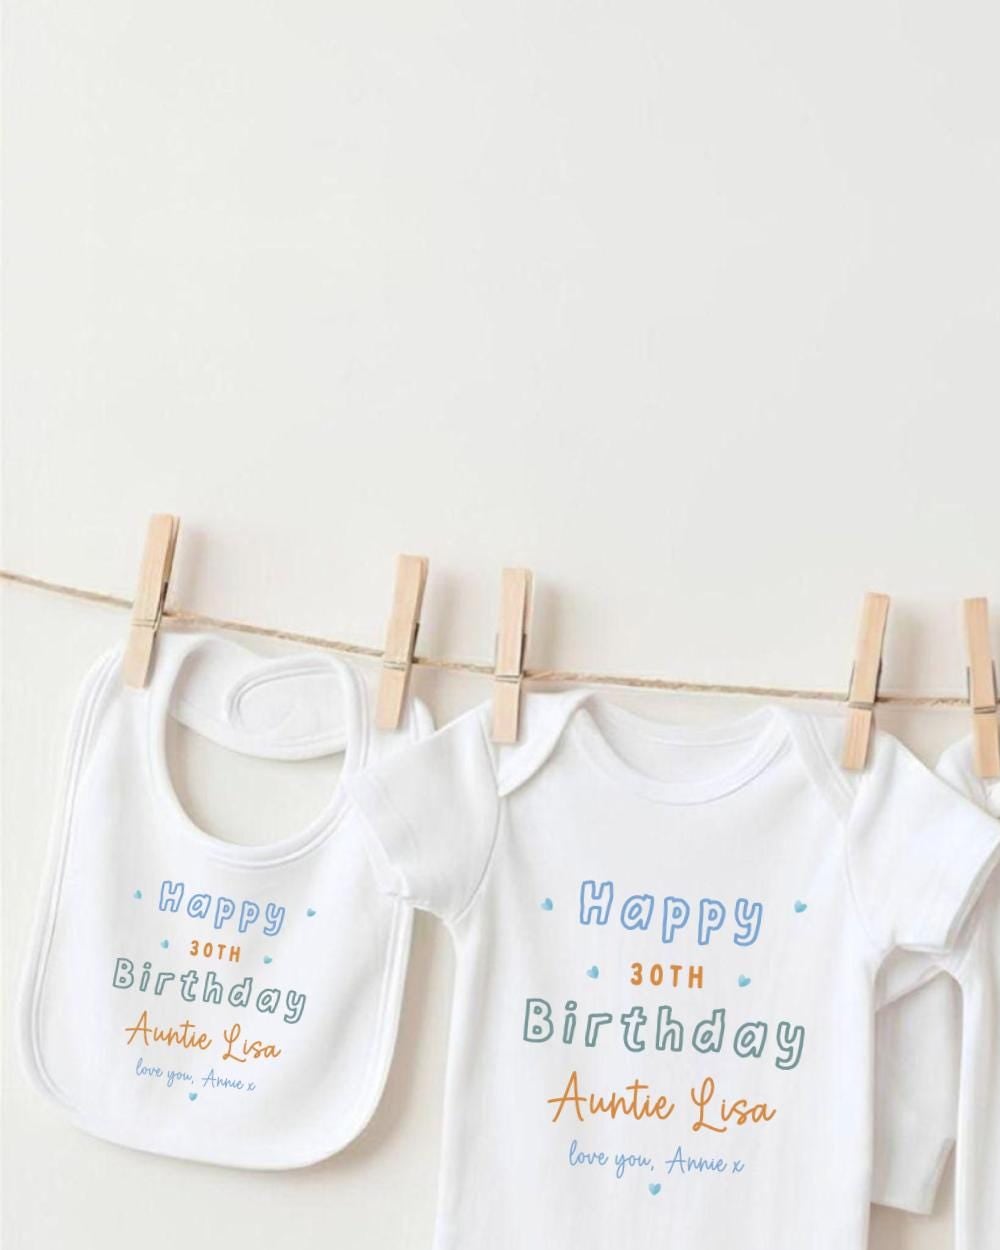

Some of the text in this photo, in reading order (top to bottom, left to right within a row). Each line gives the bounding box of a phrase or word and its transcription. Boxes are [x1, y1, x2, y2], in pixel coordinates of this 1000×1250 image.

[159, 880, 286, 937] Happy
[579, 880, 763, 947] Happy
[189, 940, 241, 963] 30TH
[630, 962, 704, 989] 30TH
[112, 957, 306, 1024] Birthday
[125, 1010, 282, 1063] Auntie Lisa
[523, 998, 805, 1071] Birthday
[136, 1057, 257, 1092] love you, Annie x
[547, 1071, 777, 1133] Auntie Lisa
[569, 1139, 744, 1179] love you, Annie x
